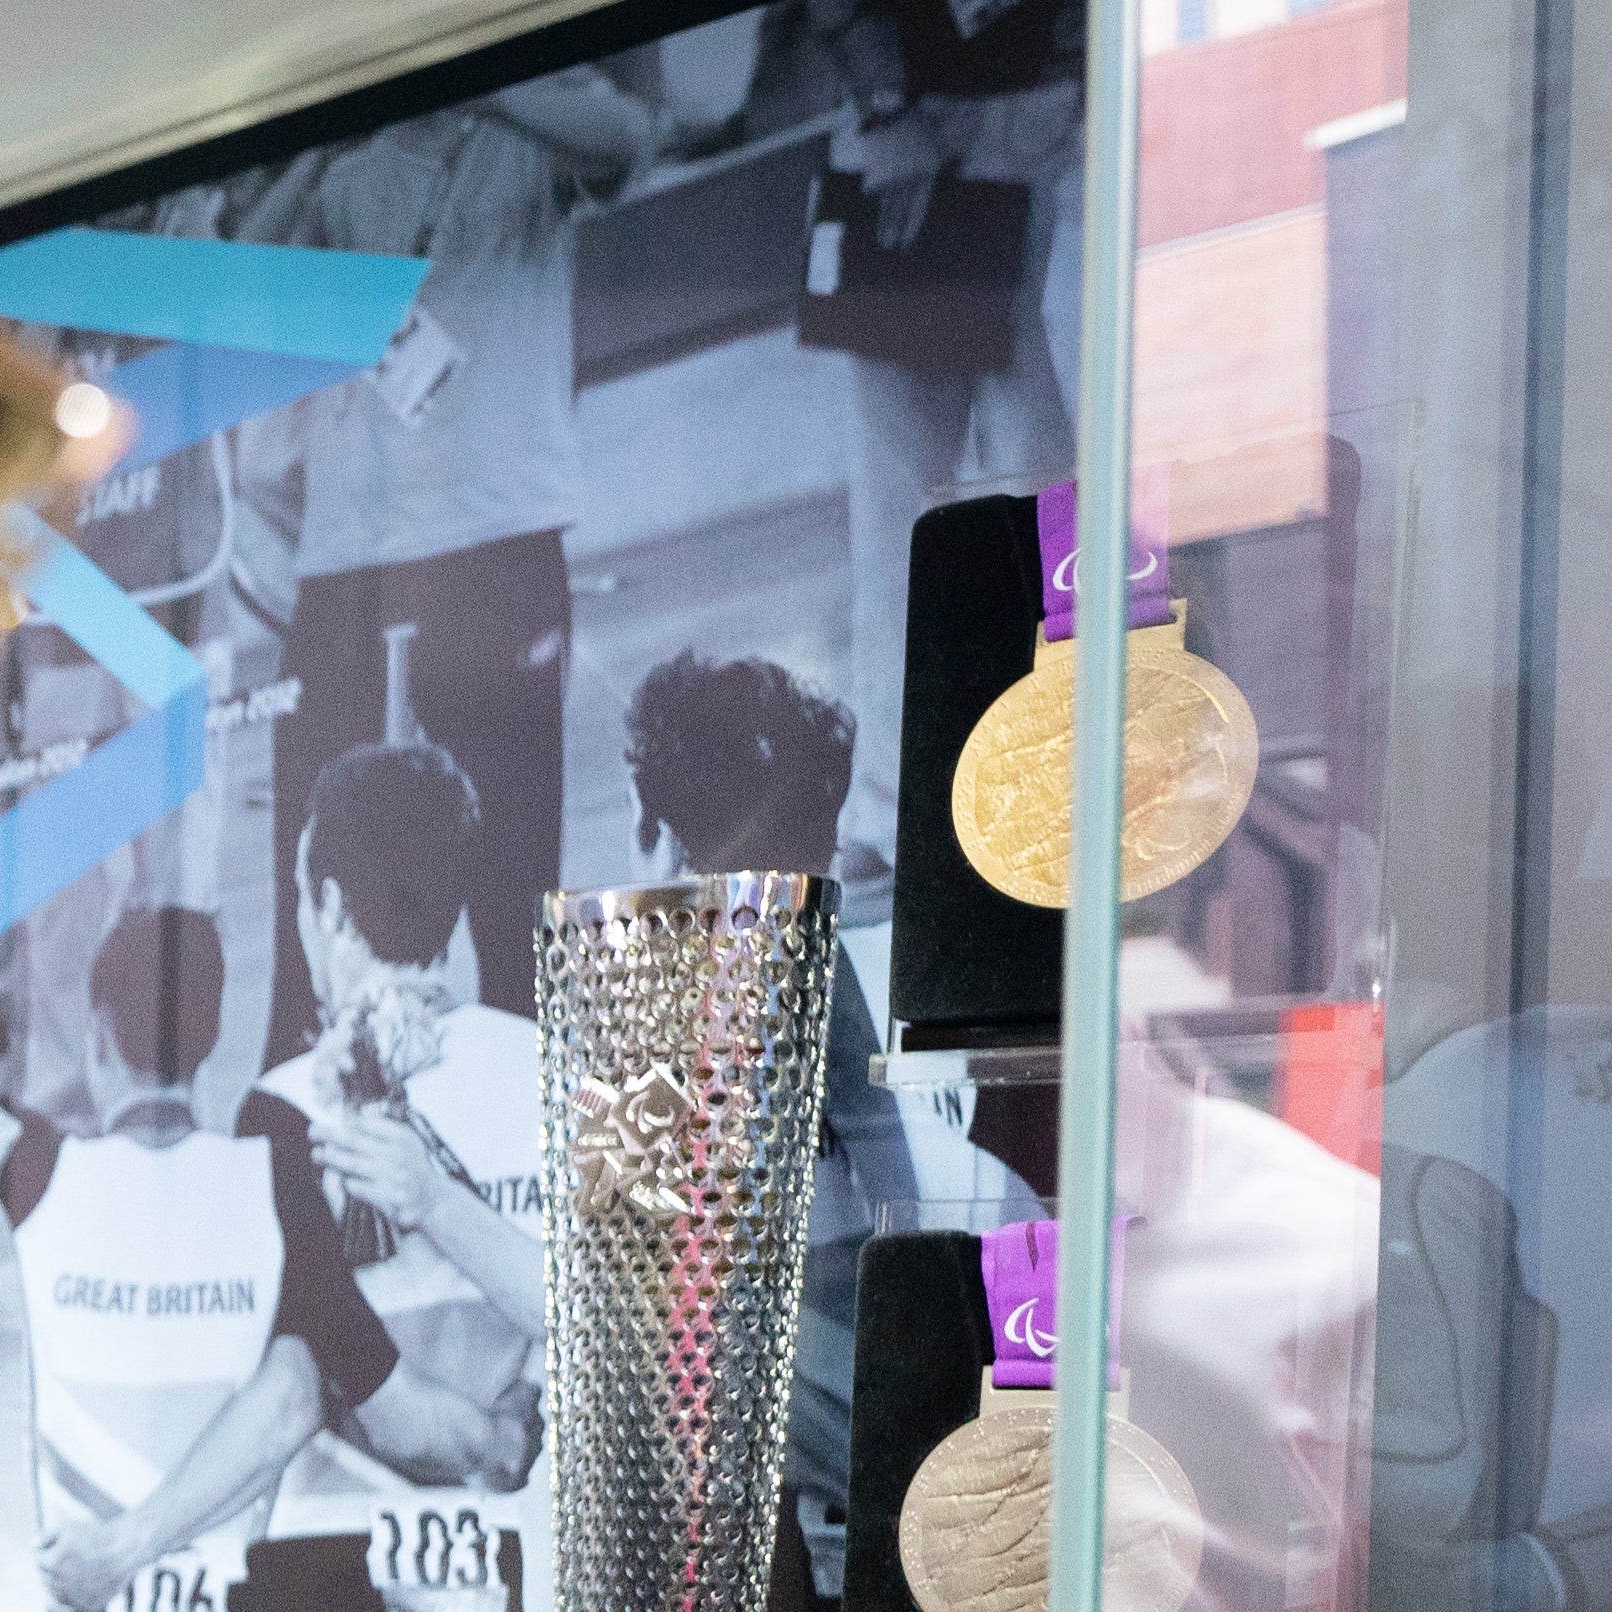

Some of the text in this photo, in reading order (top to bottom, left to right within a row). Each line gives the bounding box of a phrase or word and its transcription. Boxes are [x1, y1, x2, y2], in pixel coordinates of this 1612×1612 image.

[54, 1273, 256, 1318] GREAT BRITAIN
[379, 1508, 488, 1591] 103
